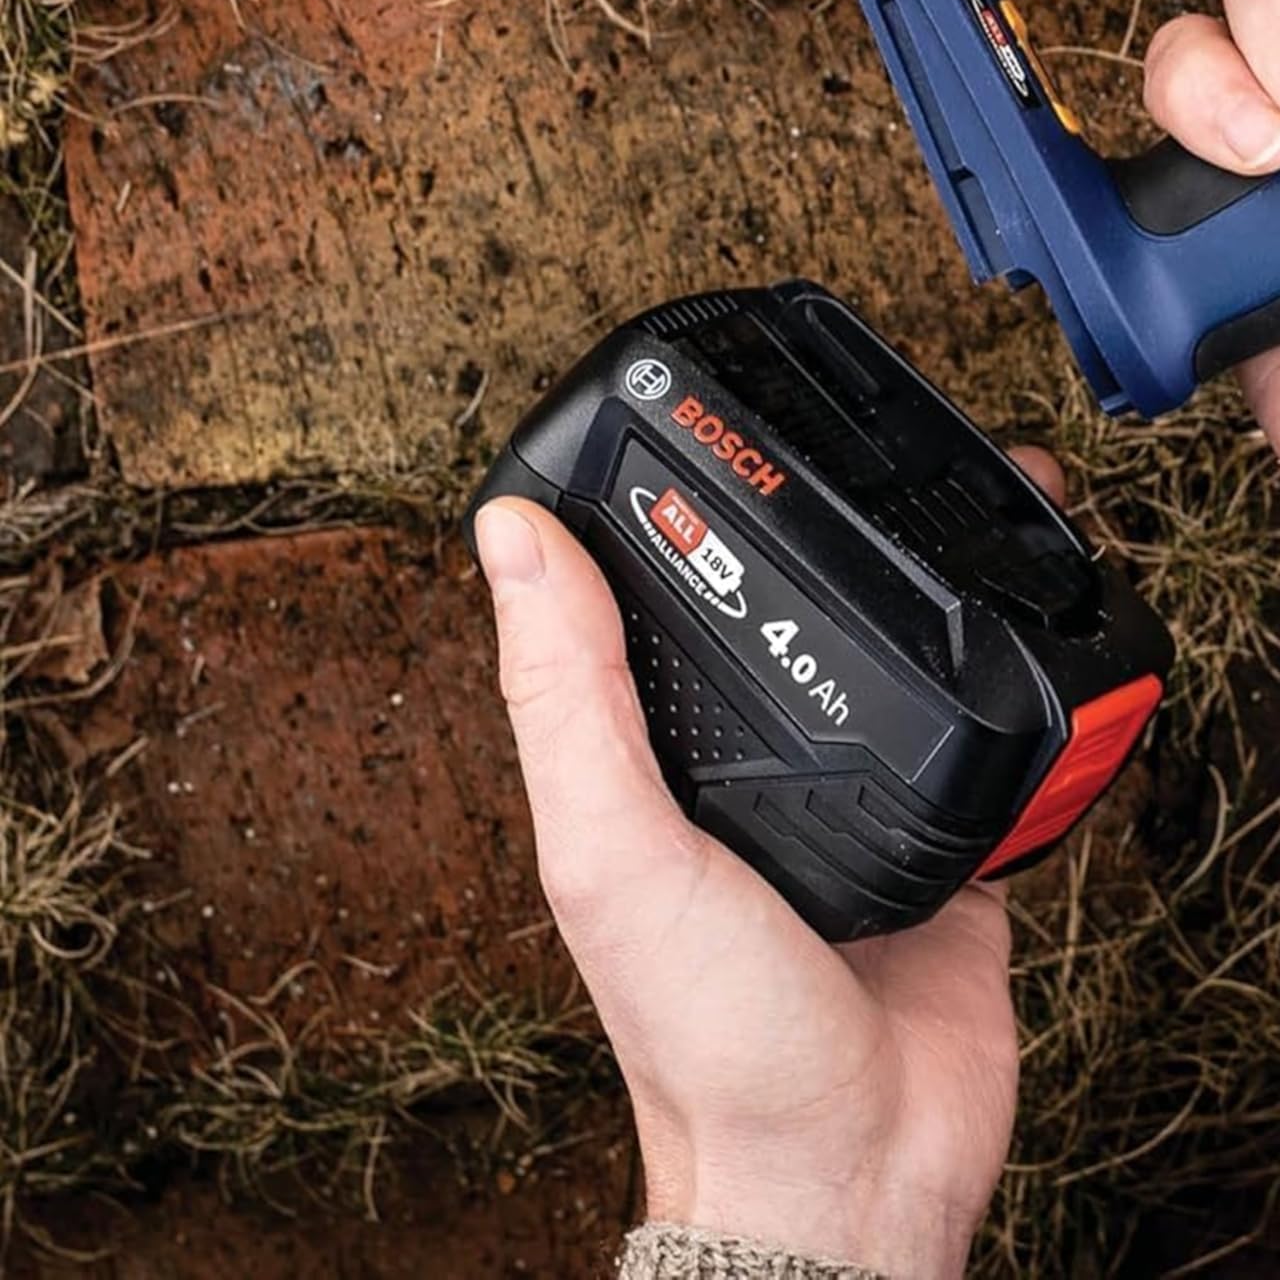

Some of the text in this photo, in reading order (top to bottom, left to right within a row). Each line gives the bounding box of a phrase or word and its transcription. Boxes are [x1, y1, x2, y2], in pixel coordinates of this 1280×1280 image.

[671, 395, 788, 496] BOSCH
[660, 503, 696, 545] ALL
[650, 534, 708, 597] ALLIANCE
[700, 547, 734, 580] 18V
[760, 619, 851, 726] 4.0 Ah
